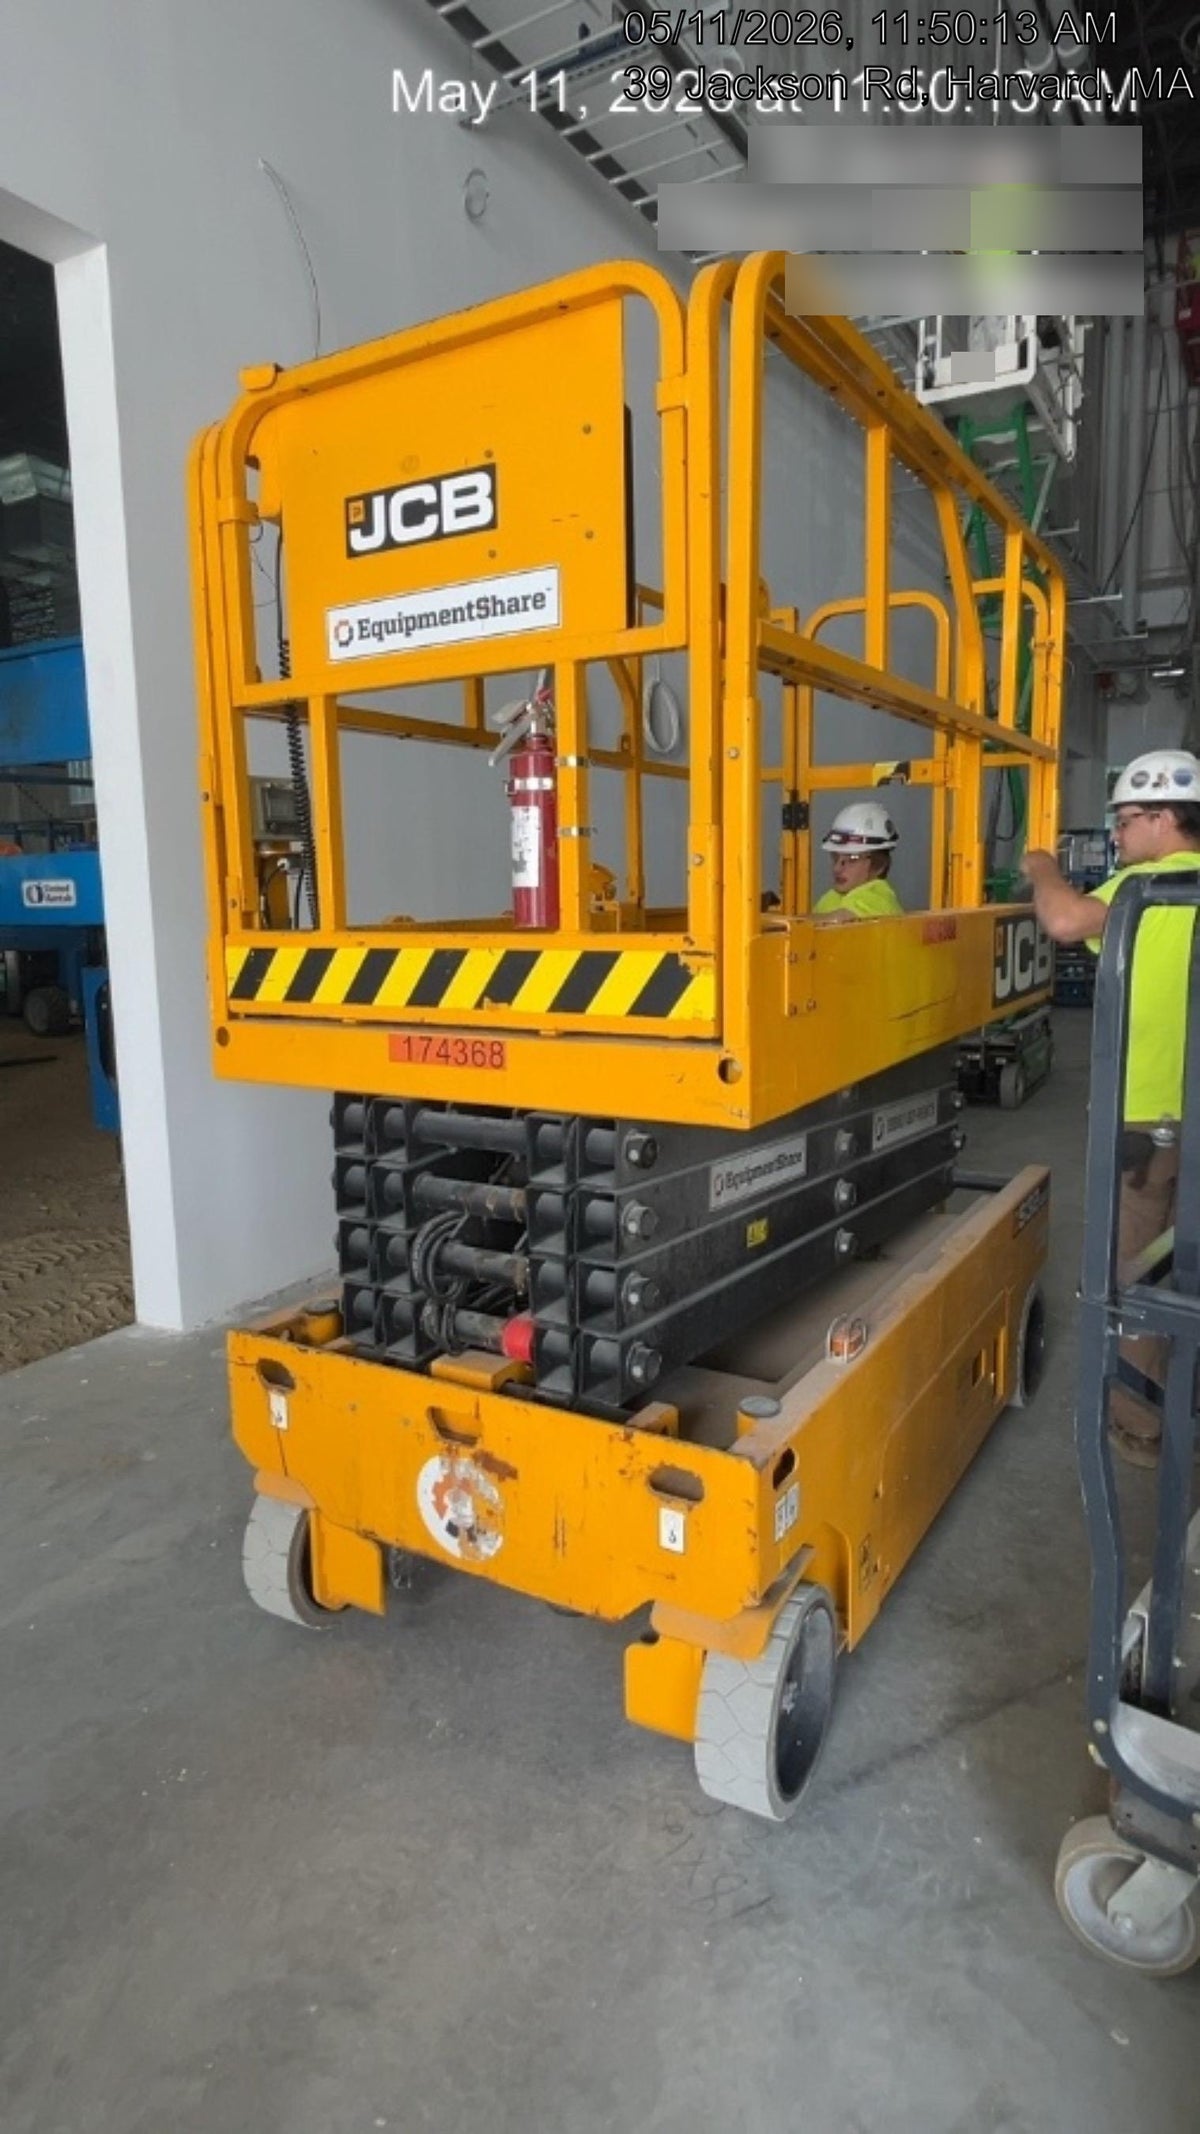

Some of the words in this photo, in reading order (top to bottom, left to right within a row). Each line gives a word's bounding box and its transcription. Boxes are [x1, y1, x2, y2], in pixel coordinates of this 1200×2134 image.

[350, 470, 494, 553] JCB
[357, 590, 547, 643] EquipmentShare
[995, 919, 1052, 999] JCB
[402, 1035, 504, 1069] 174368
